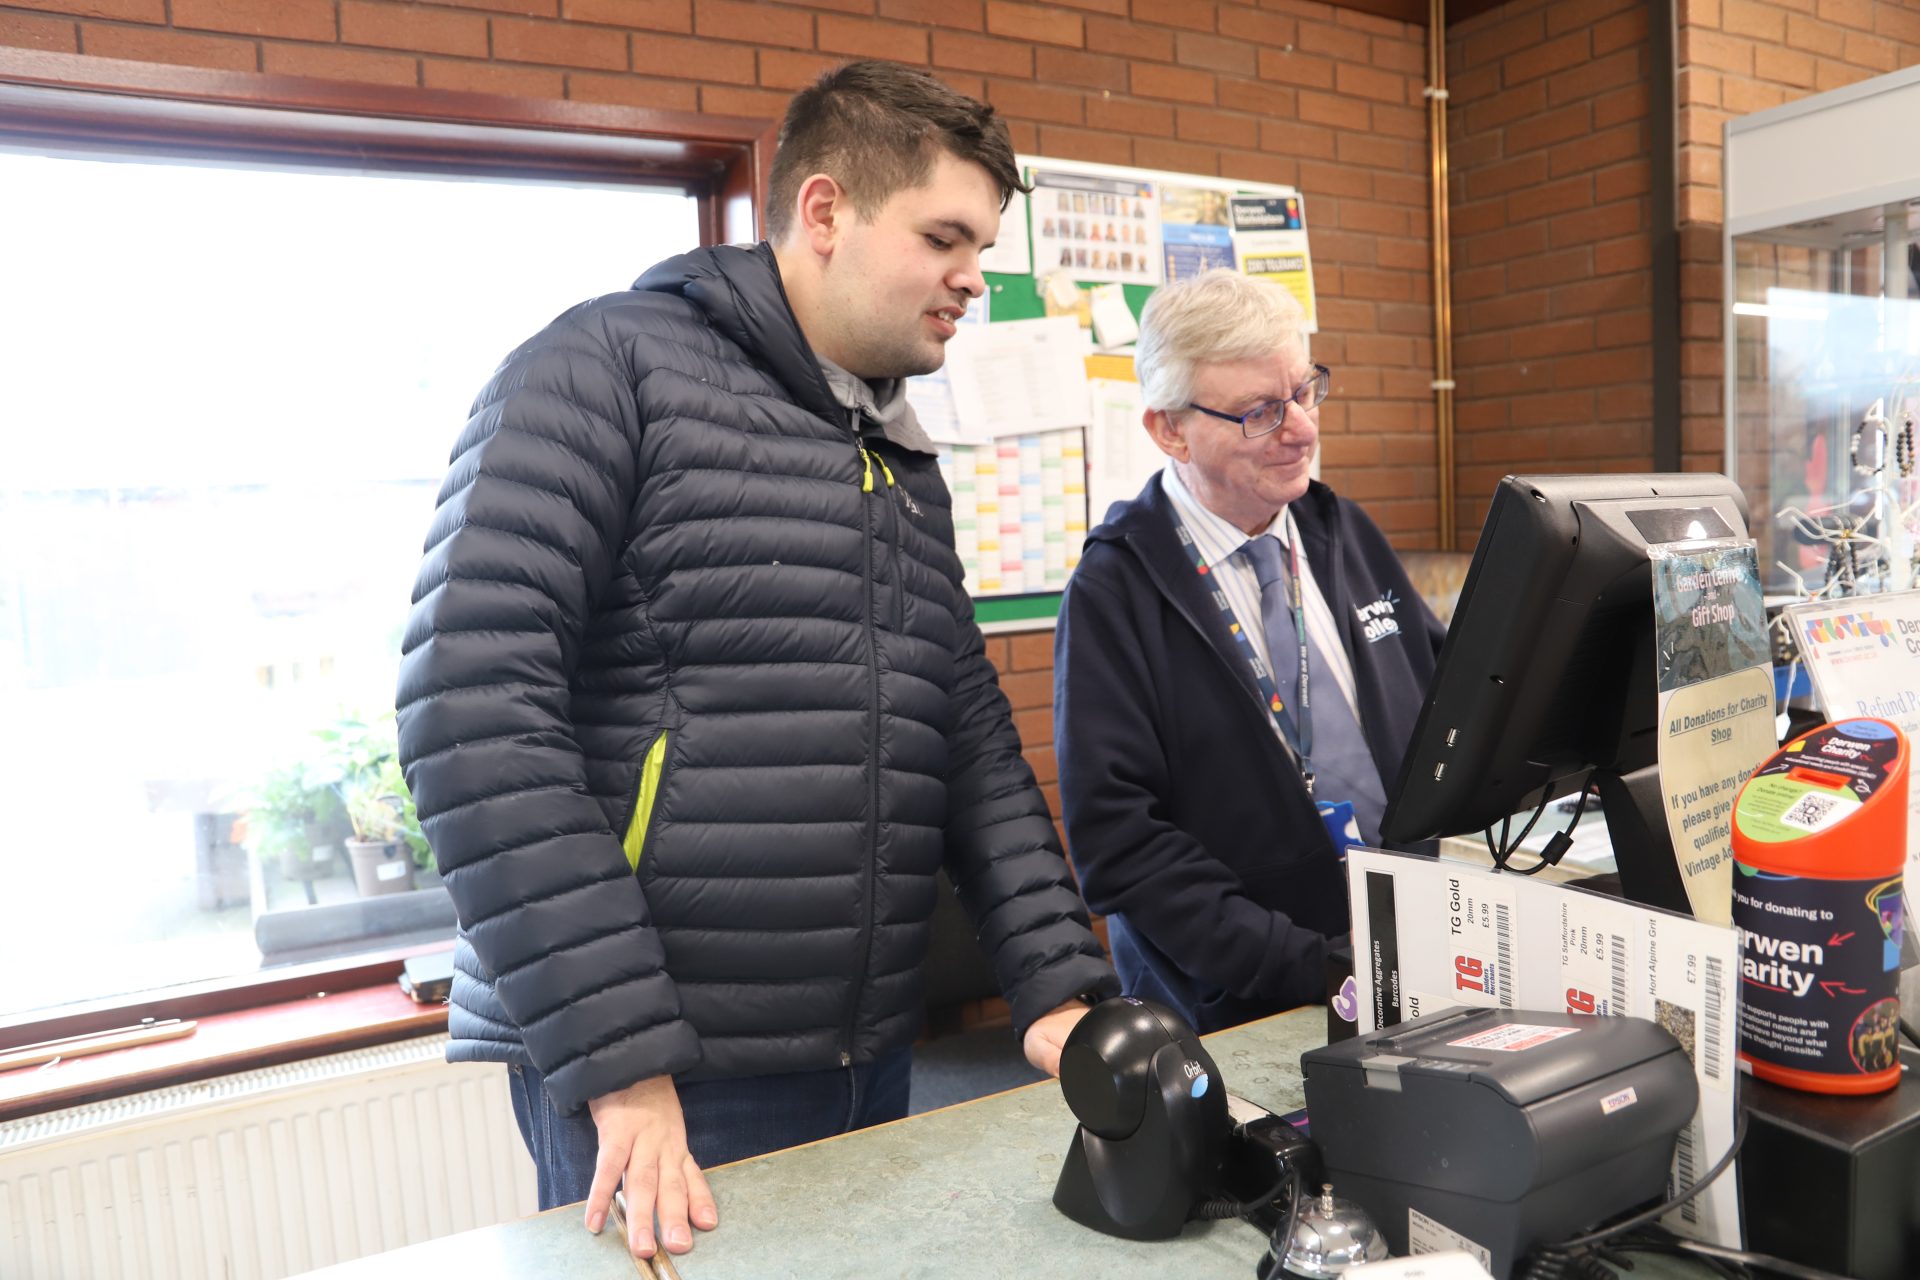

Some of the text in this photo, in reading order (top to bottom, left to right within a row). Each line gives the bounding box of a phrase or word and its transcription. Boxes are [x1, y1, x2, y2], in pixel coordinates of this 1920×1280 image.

[1676, 570, 1711, 593] Garden
[1692, 603, 1735, 628] Gift Shop
[1896, 617, 1920, 636] Der
[1905, 637, 1920, 655] Co
[1669, 693, 1768, 735] All Donations for Charity
[1856, 690, 1908, 718] Refund
[1711, 727, 1732, 743] Shop
[1827, 737, 1871, 752] Derwen
[1821, 744, 1862, 760] Charity
[1671, 794, 1680, 810] If
[1681, 790, 1698, 809] you
[1698, 782, 1720, 799] have
[1721, 775, 1737, 790] any
[1682, 808, 1712, 833] please
[1713, 801, 1731, 820] give
[1693, 822, 1731, 852] qualified
[1685, 844, 1734, 878] Vintage Ad
[1449, 878, 1462, 936] TG Gold
[1466, 897, 1475, 925] 20mm
[1481, 903, 1491, 929] £5.99
[1737, 892, 1750, 905] you
[1750, 896, 1763, 909] for
[1765, 901, 1818, 921] donating
[1820, 909, 1834, 921] to
[1580, 925, 1588, 956] 20mm
[1596, 932, 1605, 961] £5.99
[1732, 920, 1824, 966] erwen
[1561, 952, 1568, 967] TG
[1648, 918, 1658, 996] Hort Alpine Grit
[1687, 953, 1697, 985] £7.99
[1374, 940, 1385, 1030] Decorative Aggregates
[1455, 955, 1484, 993] TG
[1741, 955, 1815, 998] arity
[1391, 970, 1400, 1008] Barcodes
[1566, 987, 1596, 1015] G
[1409, 996, 1420, 1020] old
[1747, 1003, 1777, 1020] supports
[1778, 1013, 1808, 1027] people
[1808, 1019, 1829, 1030] with
[1744, 1022, 1771, 1037] achieve
[1771, 1030, 1803, 1045] beyond
[1804, 1038, 1828, 1048] what
[1772, 1023, 1798, 1034] needs
[1799, 1029, 1817, 1037] and
[1753, 1034, 1782, 1050] thought
[1784, 1043, 1824, 1057] possible.
